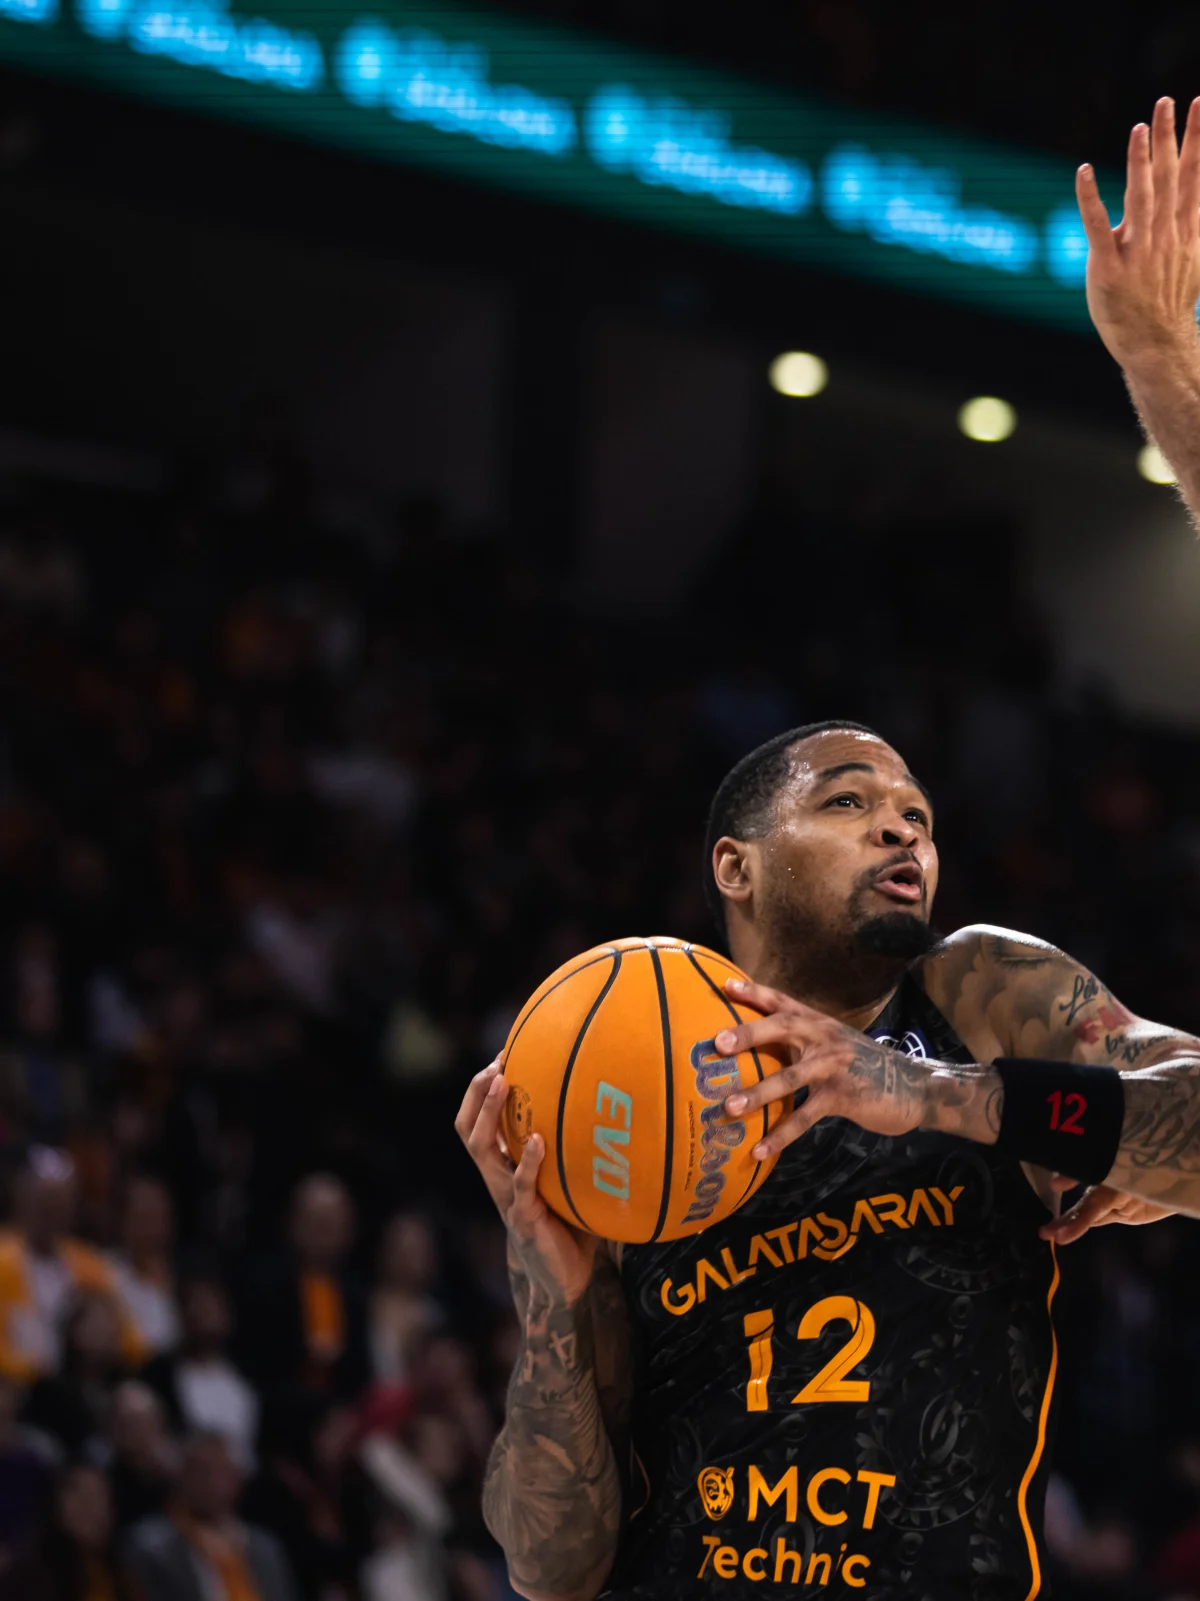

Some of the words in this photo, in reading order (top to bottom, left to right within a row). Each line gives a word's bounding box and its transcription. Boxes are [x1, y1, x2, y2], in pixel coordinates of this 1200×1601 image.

[592, 1081, 632, 1200] EVO
[680, 1039, 746, 1226] Wilson
[1046, 1090, 1088, 1136] 12
[660, 1186, 965, 1316] GALATASARAY
[743, 1295, 876, 1413] 12
[747, 1464, 897, 1530] MCT
[697, 1535, 871, 1589] Technic
